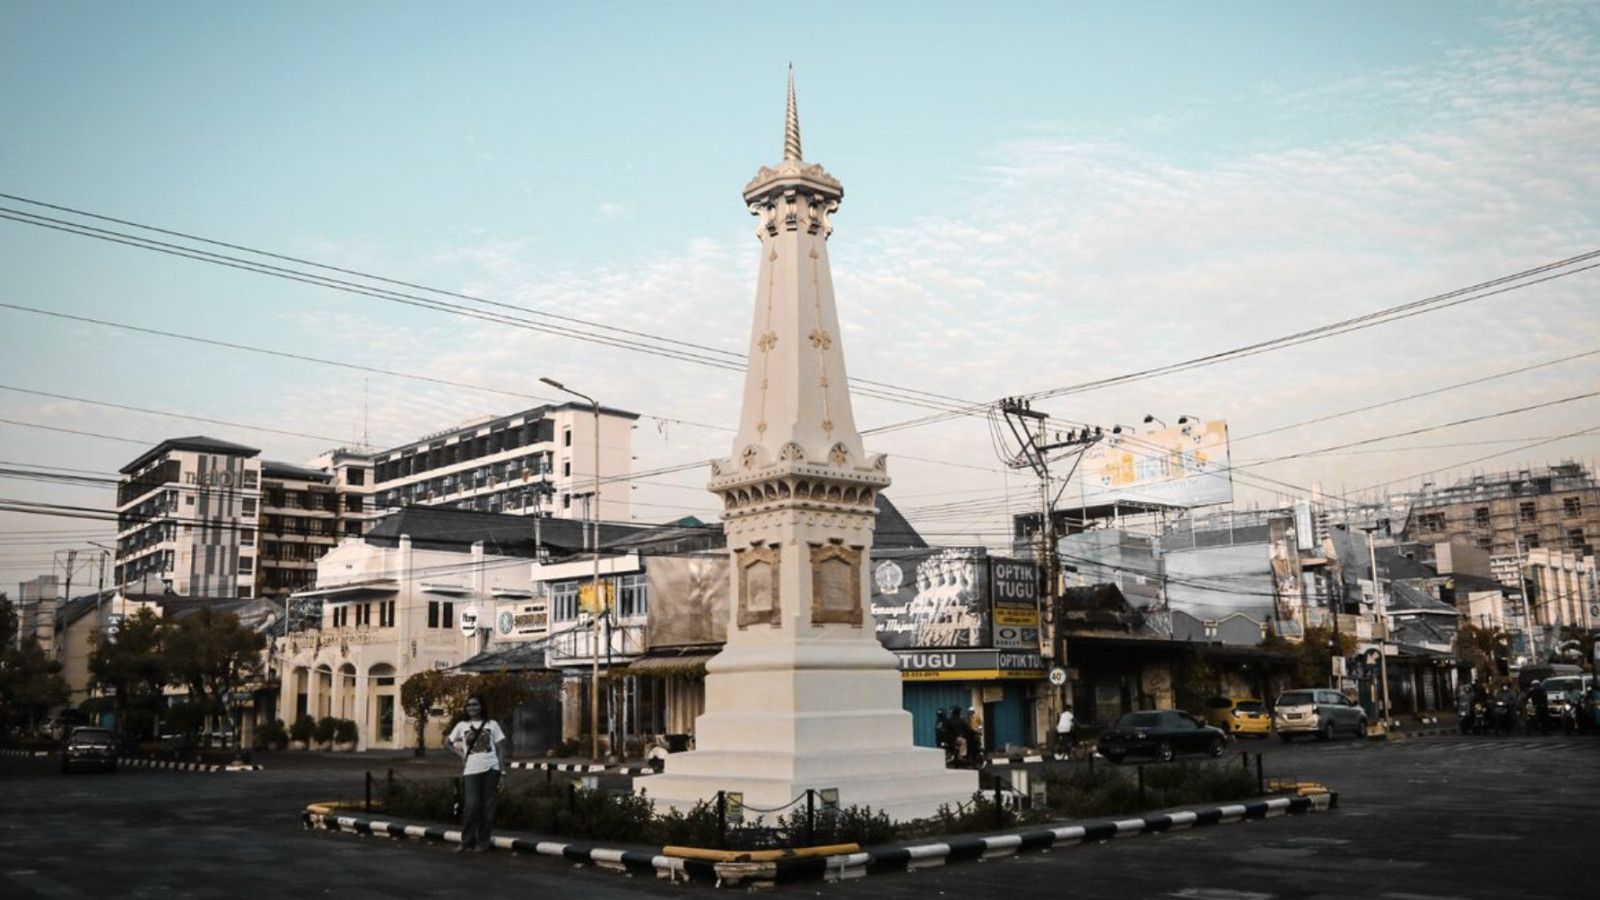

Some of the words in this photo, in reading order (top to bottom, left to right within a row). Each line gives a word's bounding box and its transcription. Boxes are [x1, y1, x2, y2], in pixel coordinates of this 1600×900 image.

[997, 564, 1034, 580] OPTIK
[997, 581, 1034, 598] TUGU
[901, 654, 957, 668] TUGU
[999, 654, 1026, 668] OPTIK
